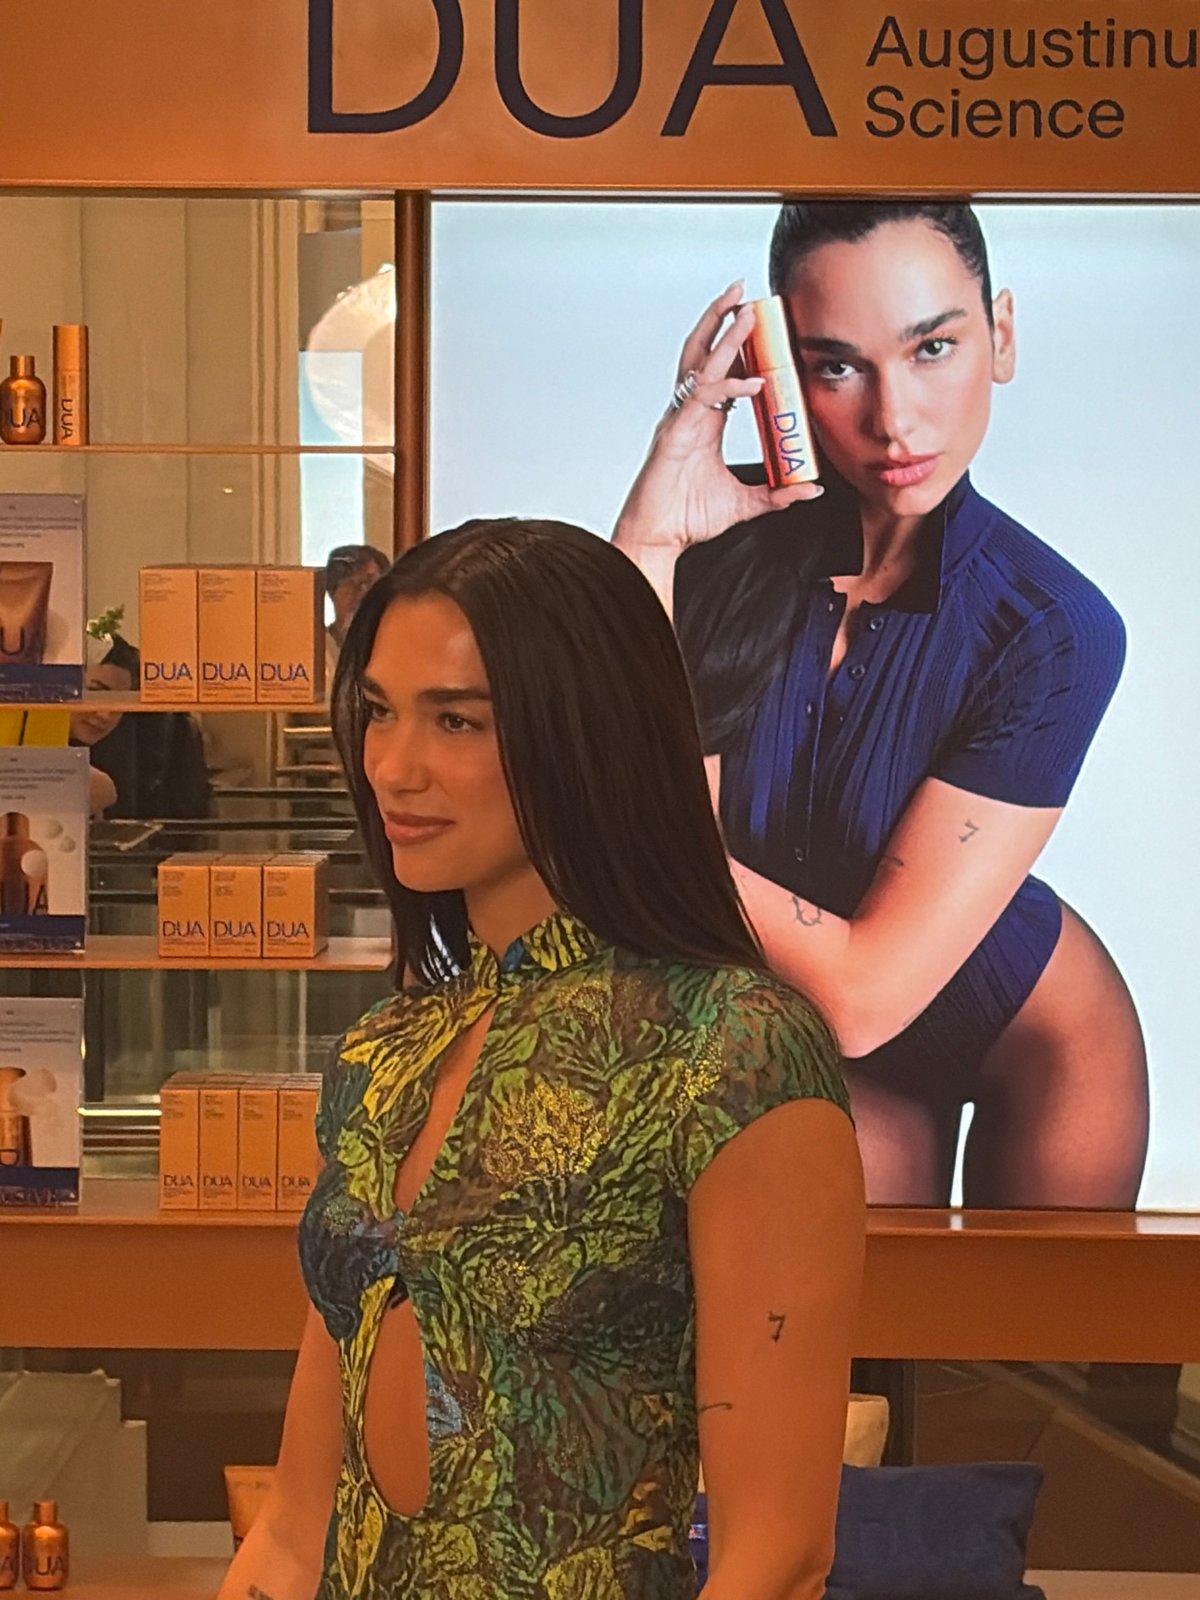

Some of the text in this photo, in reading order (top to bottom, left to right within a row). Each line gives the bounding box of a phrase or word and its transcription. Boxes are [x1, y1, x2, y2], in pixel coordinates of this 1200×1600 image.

[866, 16, 1197, 80] Augustinu
[308, 0, 837, 138] DUA
[866, 85, 1124, 138] Science
[61, 399, 73, 440] DUA
[773, 411, 805, 476] DUA
[144, 662, 192, 681] DUA
[202, 662, 251, 681] DUA
[260, 663, 309, 682] DUA
[162, 921, 205, 937] DUA
[214, 921, 256, 937] DUA
[267, 921, 310, 938] DUA
[163, 1174, 193, 1187] DUA
[203, 1175, 233, 1187] DUA
[242, 1176, 272, 1188] DUA
[281, 1175, 310, 1188] DUA
[768, 1310, 785, 1344] 7
